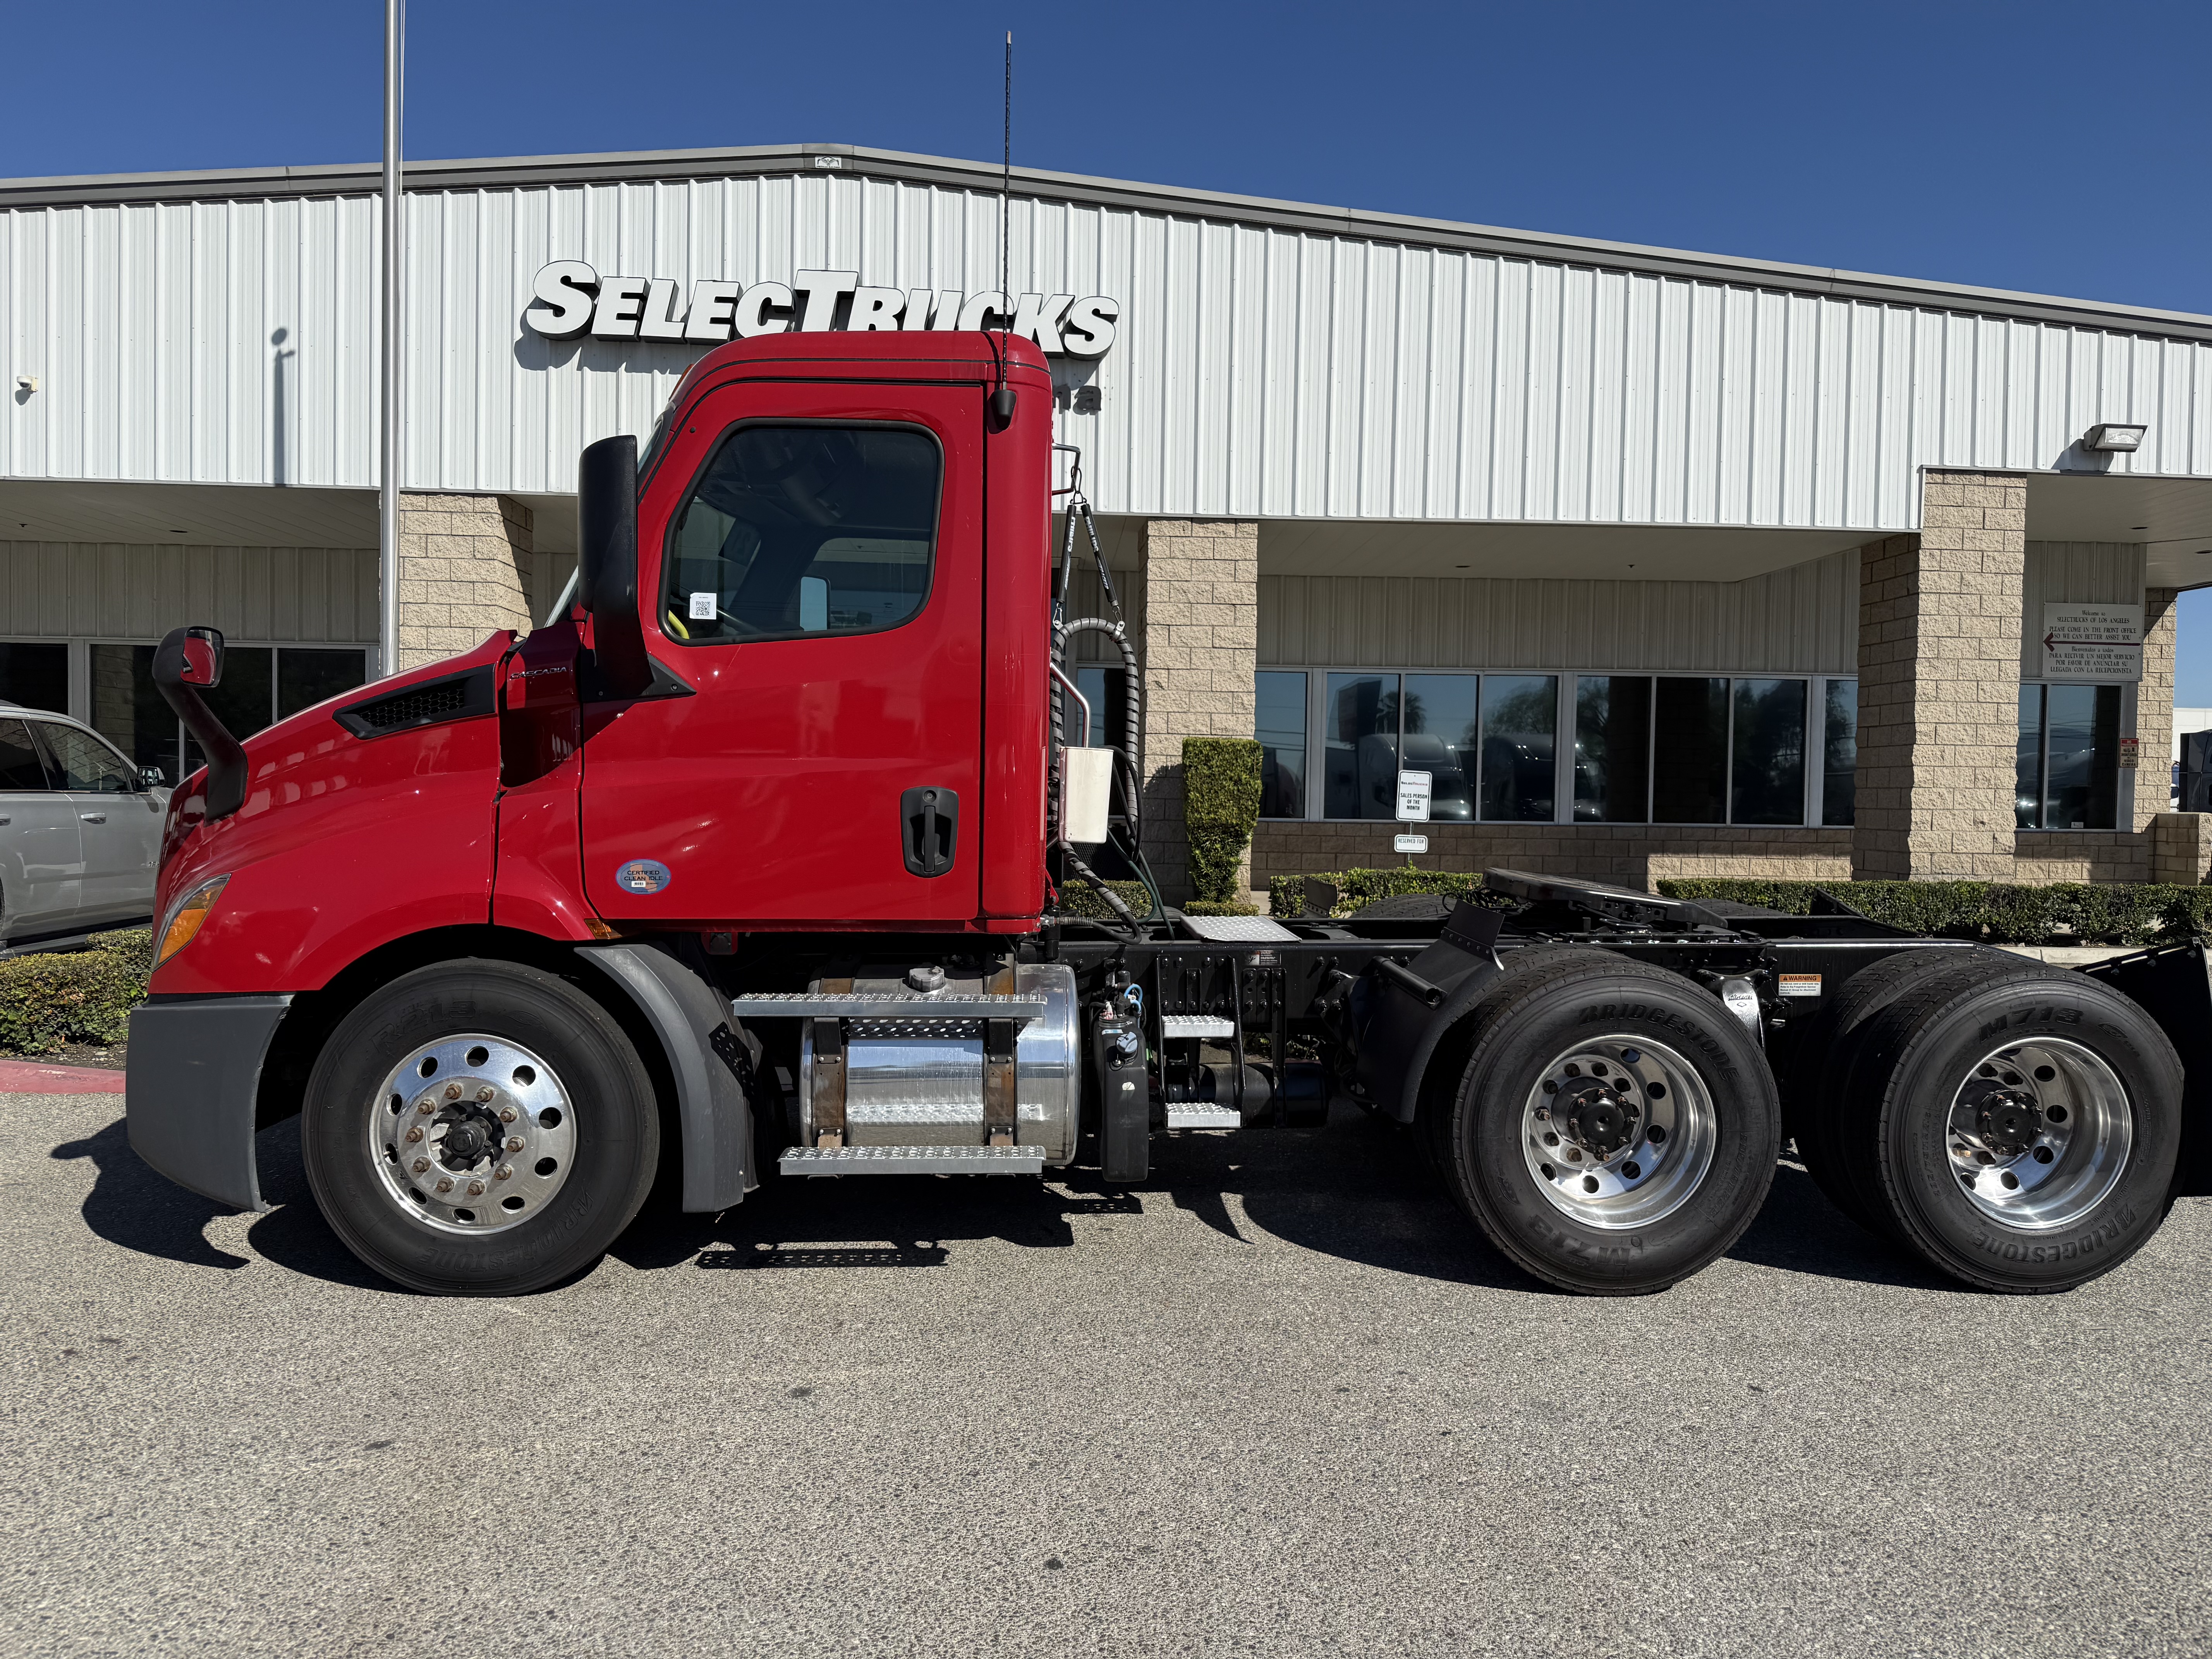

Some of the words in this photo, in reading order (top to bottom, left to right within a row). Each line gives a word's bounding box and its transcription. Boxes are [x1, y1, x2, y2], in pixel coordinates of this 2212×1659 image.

[510, 667, 567, 680] CASCADIA
[1578, 1001, 1740, 1081] BRIDGESTONE
[1978, 1007, 2084, 1043] M713
[419, 1191, 594, 1273] BRIDGESTONE
[1526, 1214, 1631, 1266] M713
[1970, 1202, 2137, 1265] BRIDGESTONE
